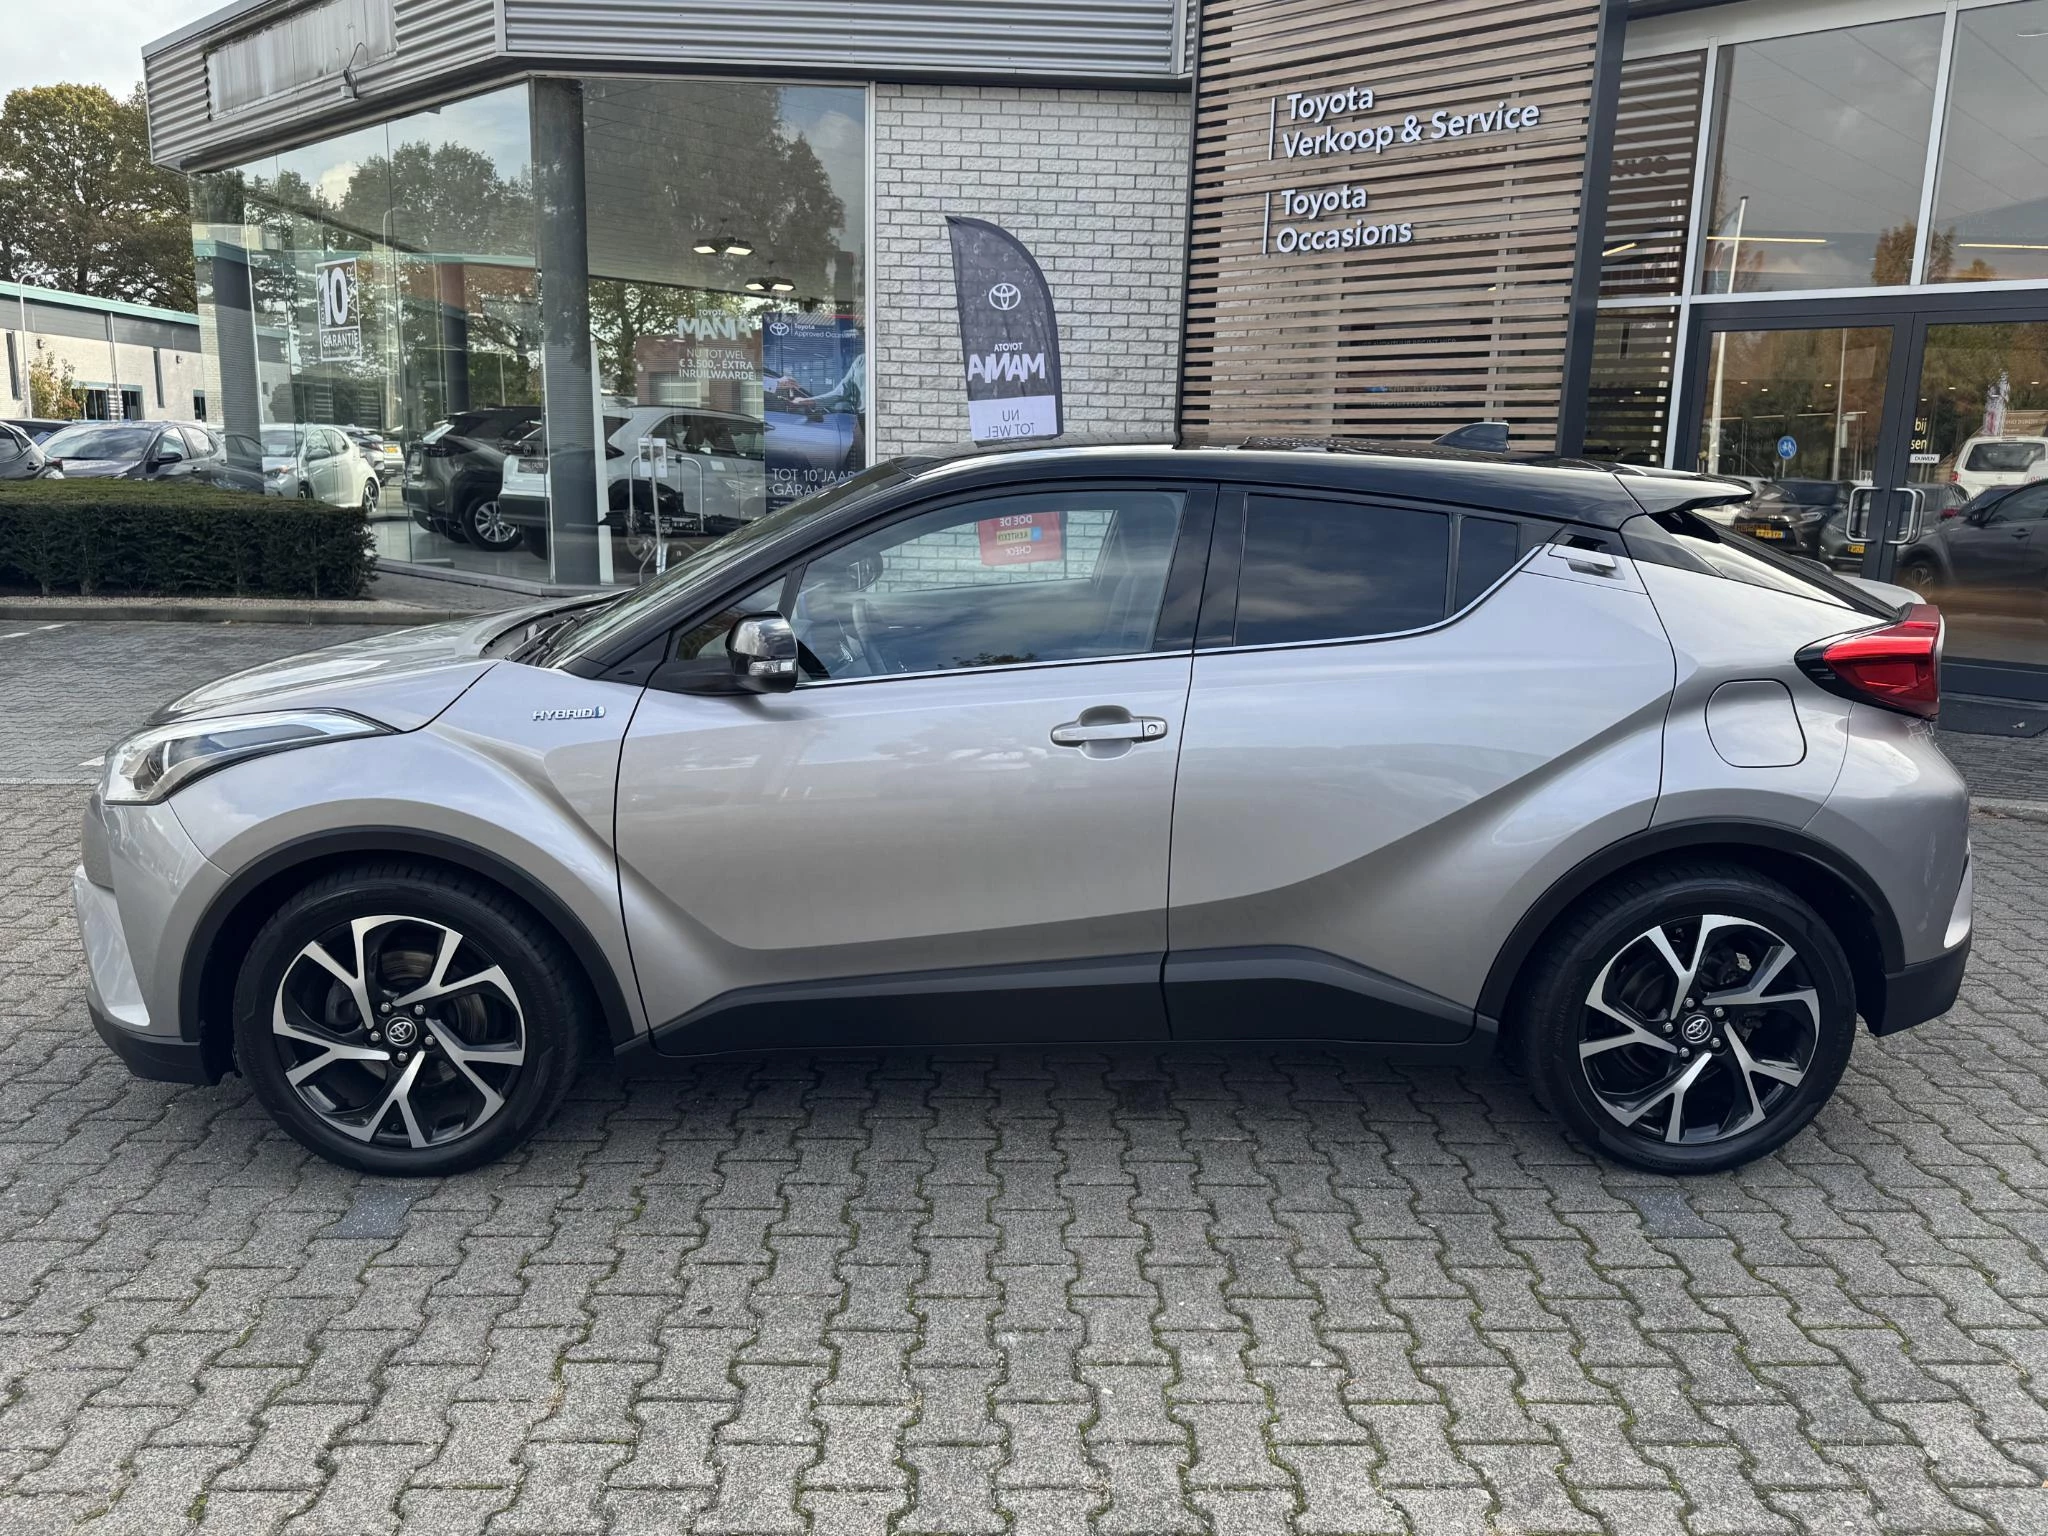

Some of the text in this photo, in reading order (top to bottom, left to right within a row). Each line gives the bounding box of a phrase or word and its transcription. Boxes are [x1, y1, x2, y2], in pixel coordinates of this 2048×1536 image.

[1286, 86, 1374, 123] Toyota
[1282, 102, 1540, 158] Verkoop & Service
[1281, 184, 1367, 220] Toyota
[1276, 219, 1413, 253] Occasions
[318, 267, 348, 326] 10
[698, 309, 727, 317] TOYOTA
[677, 317, 753, 341] MANIA
[794, 323, 815, 331] Toyota
[322, 331, 359, 348] GARANTIE
[686, 348, 746, 360] NU TOT WEL
[722, 360, 754, 370] EXTRA
[679, 369, 755, 380] INRUILWAARDE
[771, 468, 799, 481] TOT
[803, 469, 818, 482] 10
[532, 708, 594, 721] HYBRID
